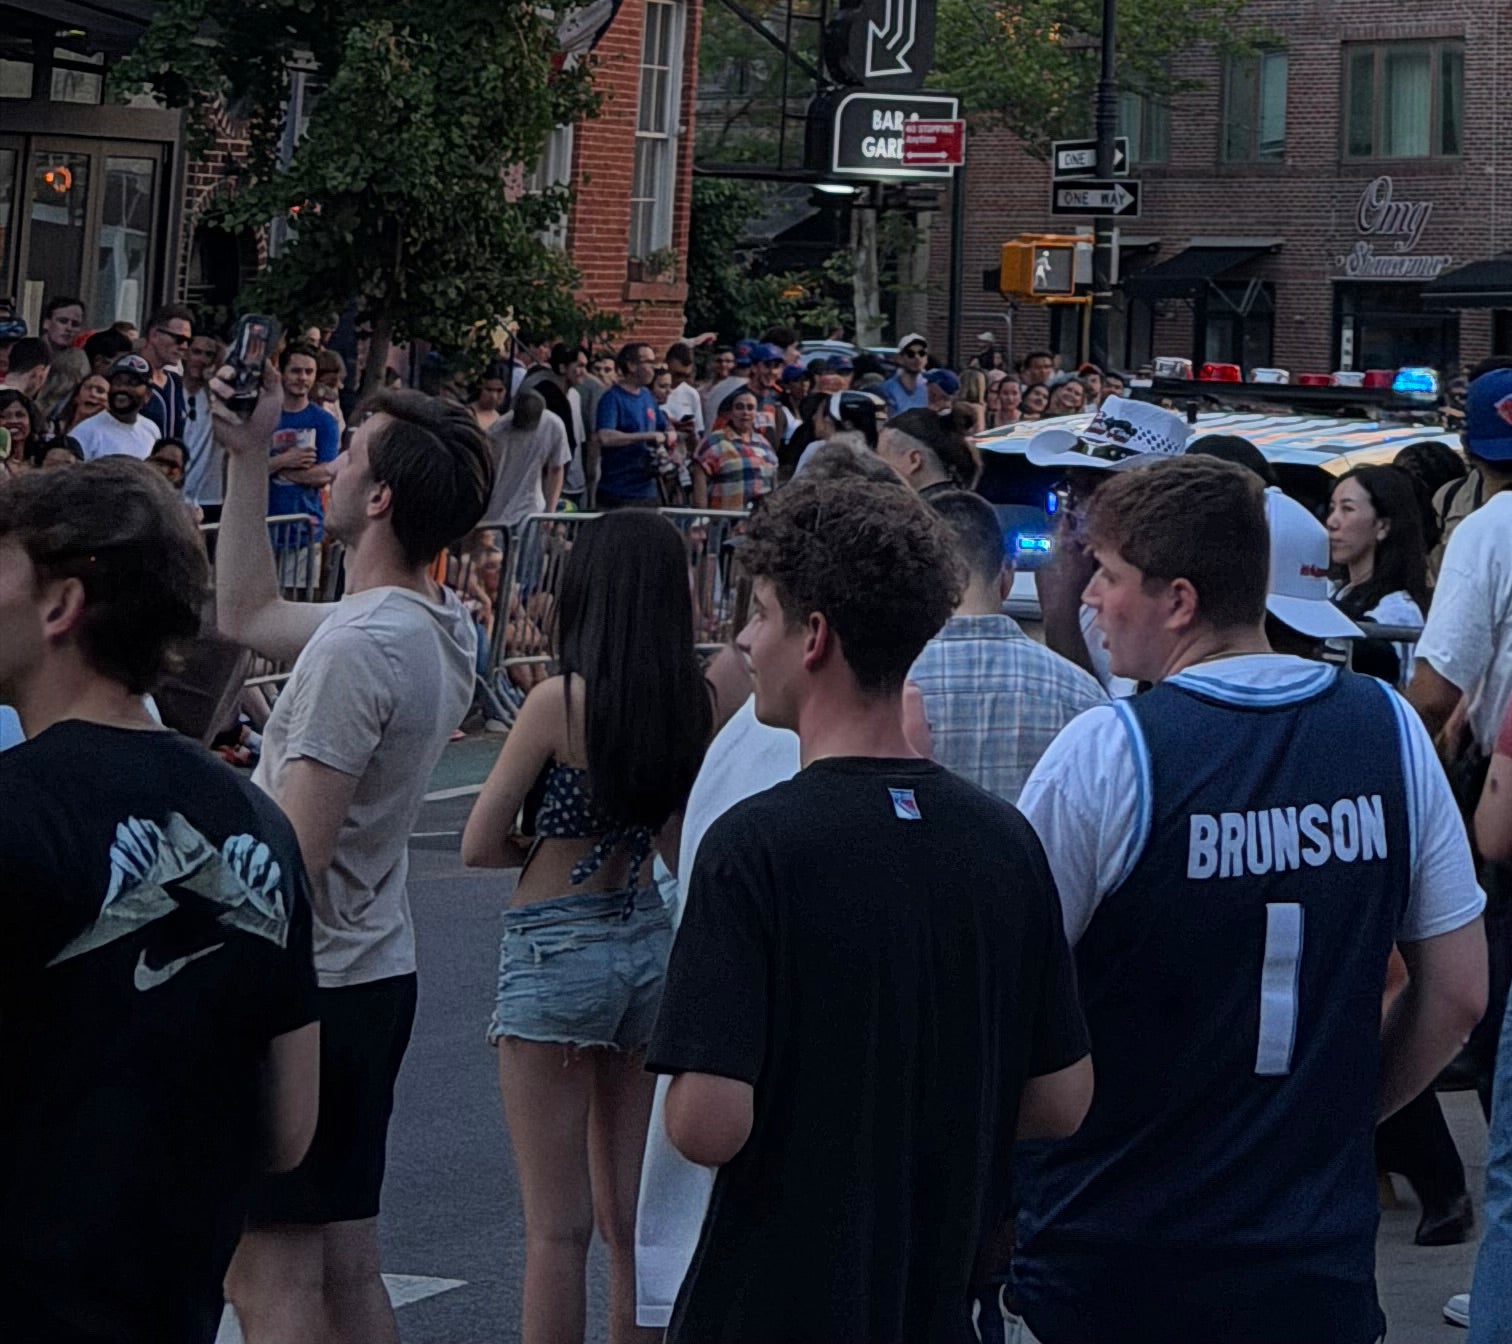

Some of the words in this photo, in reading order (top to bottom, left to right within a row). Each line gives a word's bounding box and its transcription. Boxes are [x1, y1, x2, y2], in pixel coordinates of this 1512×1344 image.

[872, 110, 904, 131] BAR
[1064, 153, 1087, 166] ONE
[1063, 192, 1089, 205] ONE
[1101, 193, 1127, 205] WAY
[1187, 794, 1388, 879] BRUNSON
[1254, 902, 1304, 1075] 1
